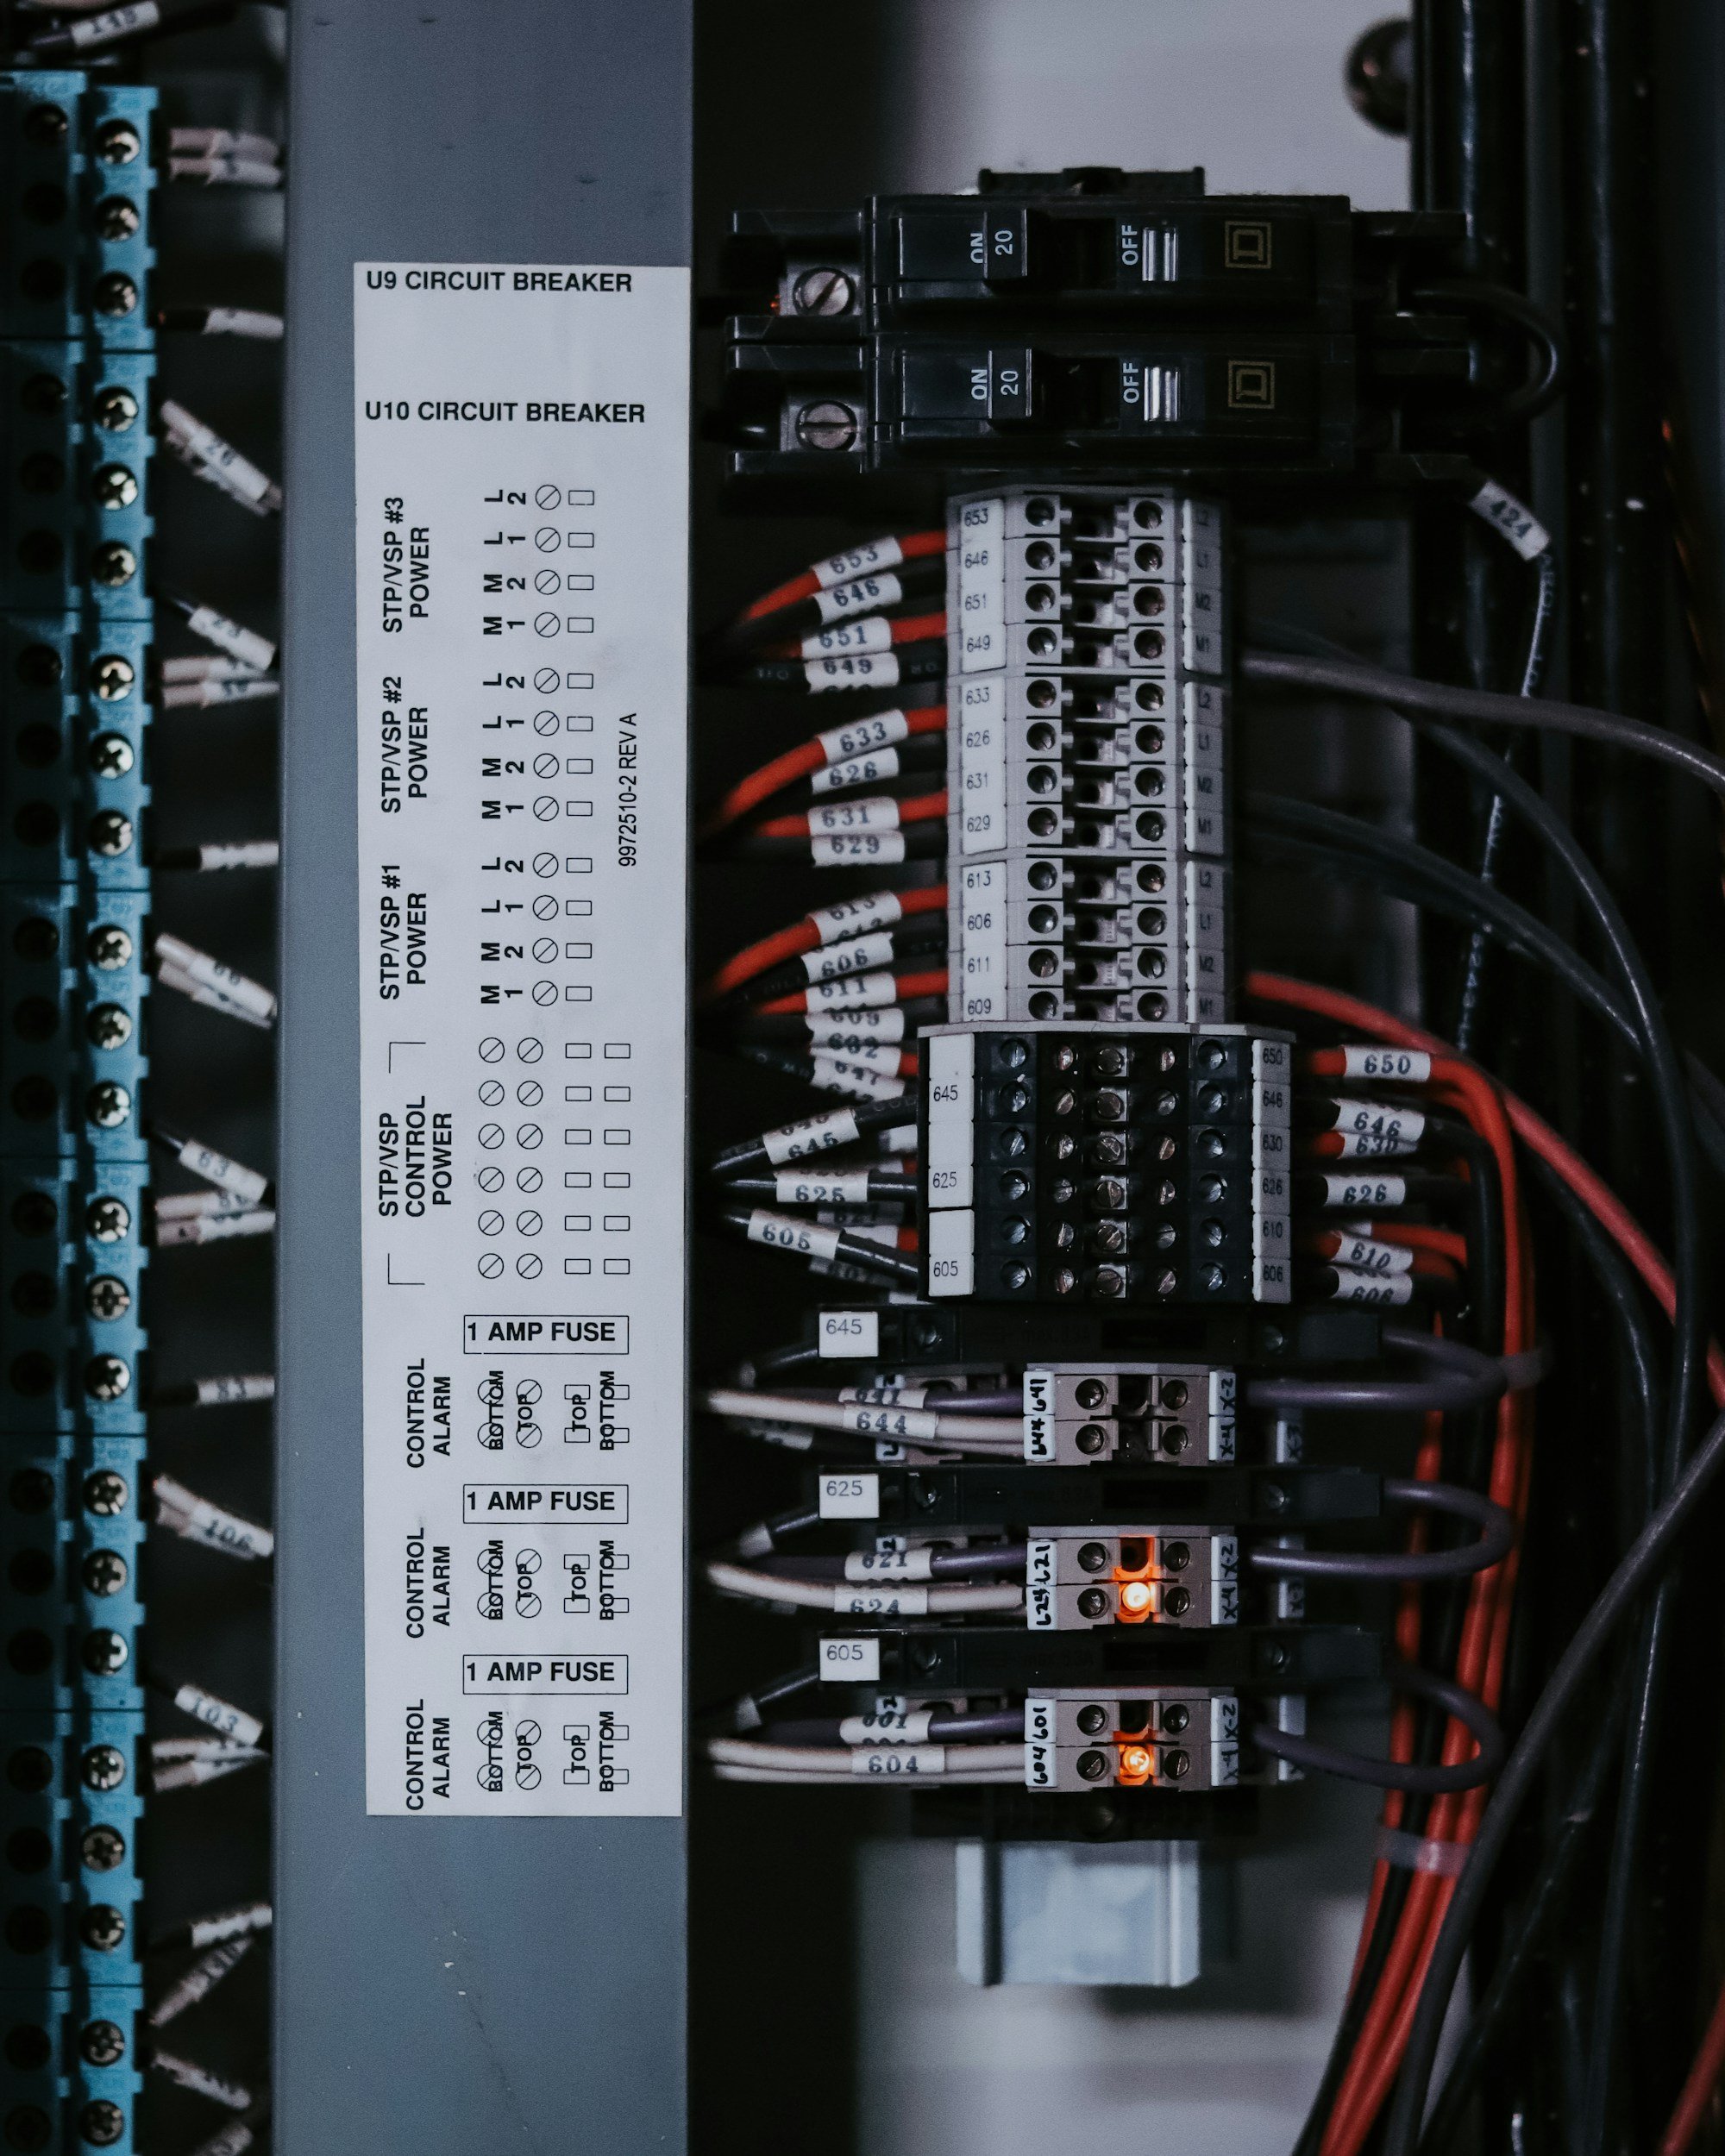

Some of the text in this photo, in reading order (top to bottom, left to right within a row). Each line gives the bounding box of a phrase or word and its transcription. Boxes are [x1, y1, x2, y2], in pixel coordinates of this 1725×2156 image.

[994, 229, 1013, 256] 20
[1121, 225, 1138, 266] OFF
[367, 271, 631, 292] U9 CIRCUIT BREAKER
[971, 369, 988, 401] ON
[1000, 371, 1019, 396] 20
[1123, 363, 1139, 404] OFF
[366, 401, 644, 423] U10 CIRCUIT BREAKER
[485, 490, 526, 505] L 2
[964, 508, 988, 526] 653
[1490, 499, 1533, 539] 424
[484, 532, 502, 544] L
[383, 498, 403, 632] STP/VSP #3
[830, 544, 878, 574] 653
[965, 550, 988, 568] 646
[410, 528, 429, 617] POWER
[484, 574, 525, 592] M 2
[833, 579, 880, 607] 646
[965, 593, 988, 611] 651
[483, 617, 502, 635] M
[820, 625, 868, 649] 651
[967, 635, 990, 653] 649
[824, 659, 873, 674] 649
[483, 674, 524, 688] L 2
[966, 686, 989, 704] 633
[483, 716, 501, 729] L
[381, 677, 401, 812] STP/VSP #2
[840, 721, 887, 752] 633
[966, 730, 990, 747] 626
[408, 708, 427, 798] POWER
[482, 758, 524, 776] M 2
[830, 761, 876, 787] 626
[618, 713, 637, 866] 9972510-2 REV A
[967, 773, 988, 789] 631
[482, 801, 500, 818] M
[822, 806, 869, 828] 631
[967, 815, 991, 832] 629
[831, 836, 880, 854] 629
[482, 857, 524, 873] L 2
[967, 870, 991, 888] 613
[481, 900, 500, 912] L
[380, 866, 400, 1000] STP/VSP #1
[968, 913, 991, 931] 606
[407, 893, 426, 984] POWER
[481, 943, 523, 961] M 2
[822, 949, 868, 976] 606
[968, 956, 989, 972] 611
[481, 986, 499, 1004] M
[968, 999, 991, 1015] 609
[1264, 1049, 1283, 1064] 650
[1364, 1054, 1411, 1075] 650
[933, 1085, 958, 1102] 645
[1264, 1091, 1283, 1108] 646
[1354, 1112, 1401, 1137] 646
[1264, 1134, 1283, 1151] 630
[379, 1113, 398, 1216] STP/VSP
[405, 1096, 425, 1217] CONTROL
[432, 1113, 452, 1205] POWER
[933, 1172, 957, 1188] 625
[1263, 1178, 1283, 1194] 626
[1343, 1184, 1387, 1204] 626
[762, 1223, 810, 1250] 605
[1264, 1220, 1283, 1238] 610
[1351, 1242, 1390, 1269] 610
[933, 1260, 958, 1277] 605
[1264, 1264, 1283, 1282] 606
[467, 1322, 615, 1341] 1 AMP FUSE
[826, 1319, 863, 1335] 645
[1030, 1379, 1047, 1412] 641
[407, 1358, 424, 1468] CONTROL
[433, 1377, 450, 1456] ALARM
[489, 1370, 504, 1451] BOTTOM
[518, 1393, 532, 1432] TOP
[572, 1394, 587, 1432] TOP
[599, 1371, 615, 1451] BOTTOM
[857, 1412, 906, 1433] 644
[826, 1480, 862, 1496] 625
[467, 1491, 614, 1511] 1 AMP FUSE
[862, 1551, 907, 1569] 621
[406, 1527, 423, 1638] CONTROL
[433, 1546, 449, 1626] ALARM
[489, 1540, 504, 1620] BOTTOM
[518, 1564, 532, 1601] TOP
[572, 1564, 587, 1601] TOP
[599, 1540, 615, 1620] BOTTOM
[826, 1645, 863, 1661] 605
[467, 1662, 614, 1682] 1 AMP FUSE
[1032, 1708, 1049, 1739] 601
[406, 1699, 423, 1810] CONTROL
[433, 1718, 449, 1798] ALARM
[488, 1711, 504, 1792] BOTTOM
[518, 1734, 532, 1773] TOP
[572, 1735, 587, 1773] TOP
[599, 1711, 615, 1792] BOTTOM
[869, 1755, 919, 1773] 604
[1032, 1745, 1048, 1784] 604
